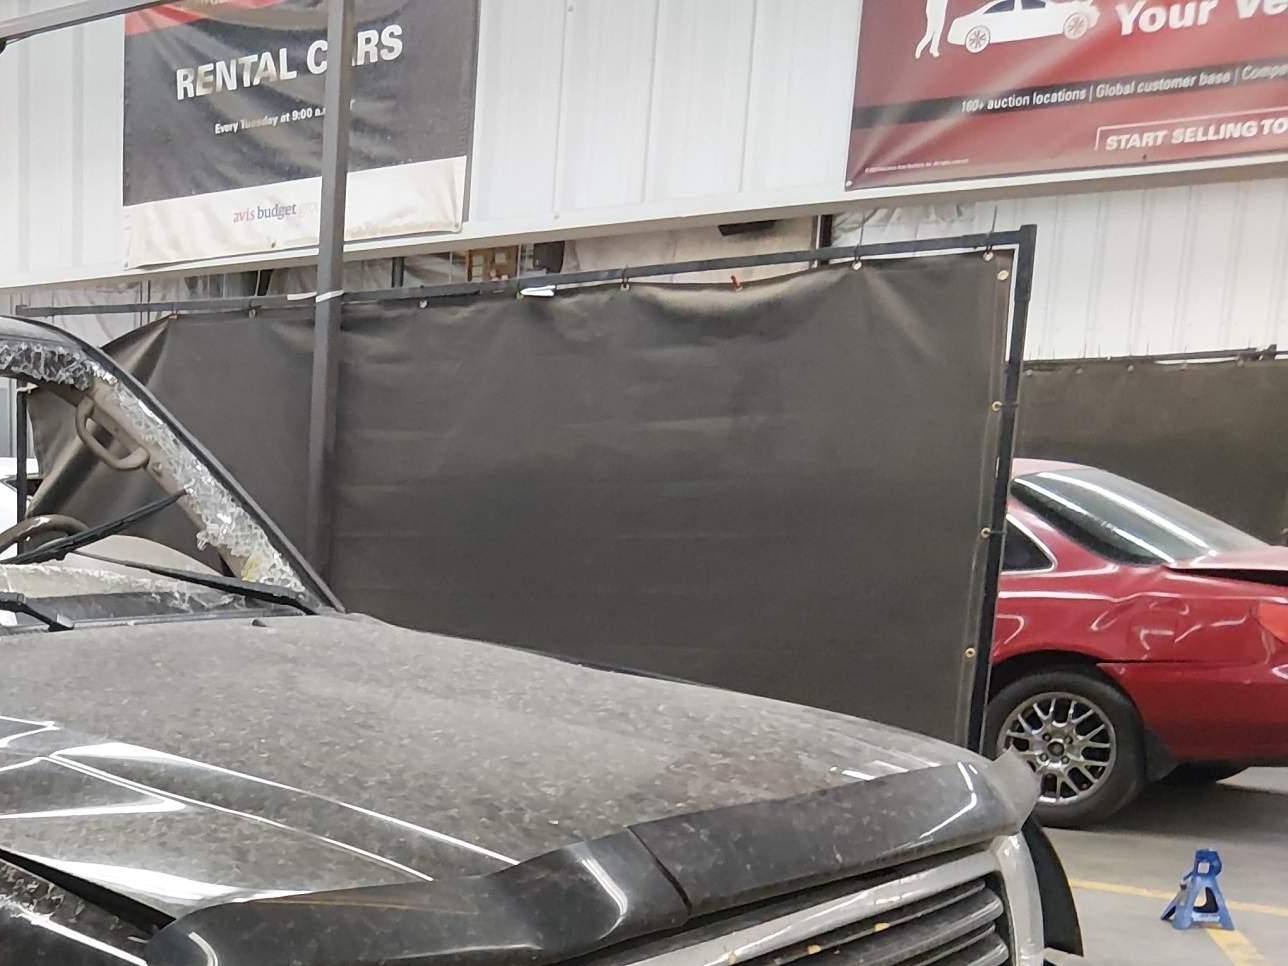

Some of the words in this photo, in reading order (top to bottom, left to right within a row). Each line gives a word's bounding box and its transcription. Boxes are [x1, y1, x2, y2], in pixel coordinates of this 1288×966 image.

[1115, 0, 1218, 36] Your
[175, 48, 297, 101] RENTAL
[306, 24, 404, 76] CRS
[987, 95, 1030, 110] auction
[1032, 87, 1086, 105] locations
[1096, 81, 1135, 98] Global
[1137, 75, 1196, 93] customer
[1199, 71, 1230, 86] base
[215, 120, 239, 135] Every
[280, 112, 290, 123] at
[292, 107, 312, 121] 9:00
[1105, 130, 1167, 151] START
[1171, 120, 1258, 144] SELLING
[233, 208, 255, 223] avis
[257, 203, 297, 220] budget
